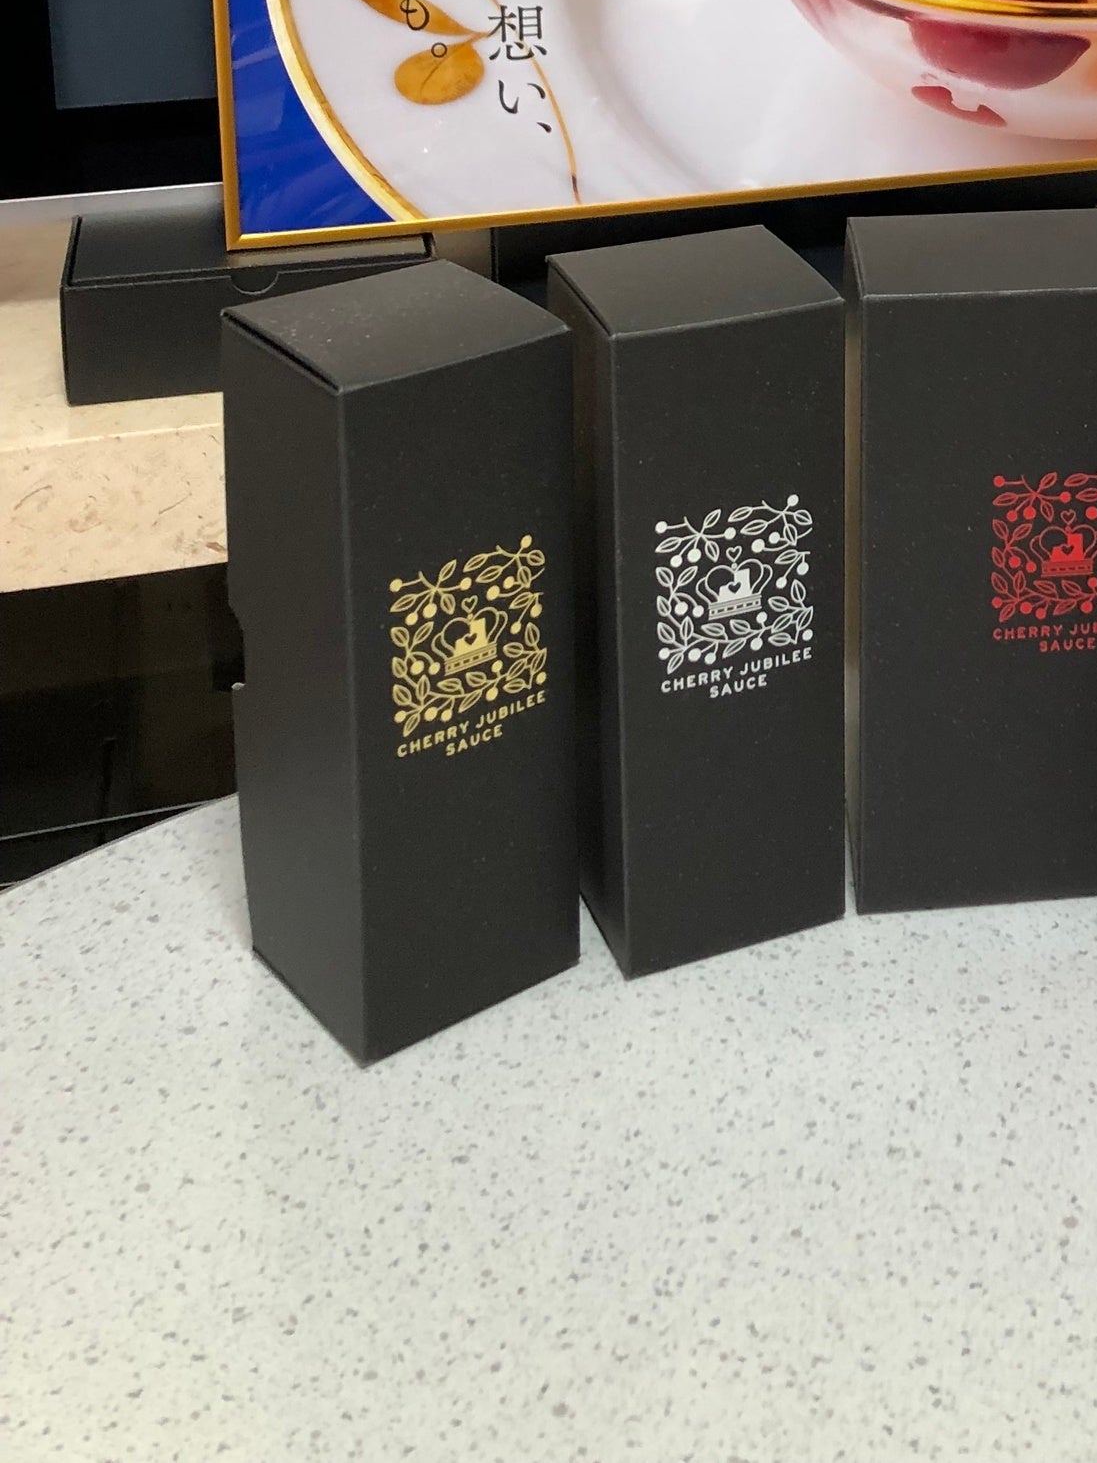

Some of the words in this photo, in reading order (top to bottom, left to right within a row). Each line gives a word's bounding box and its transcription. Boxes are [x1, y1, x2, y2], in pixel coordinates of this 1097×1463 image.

[992, 624, 1063, 640] CHERRY
[1039, 637, 1097, 653] SAUCE
[660, 665, 734, 693] CHERRY
[740, 646, 812, 676] JUBILEE
[709, 674, 768, 698] SAUCE
[396, 720, 470, 758] CHERRY
[475, 689, 546, 730] JUBILEE
[445, 724, 503, 756] SAUCE
